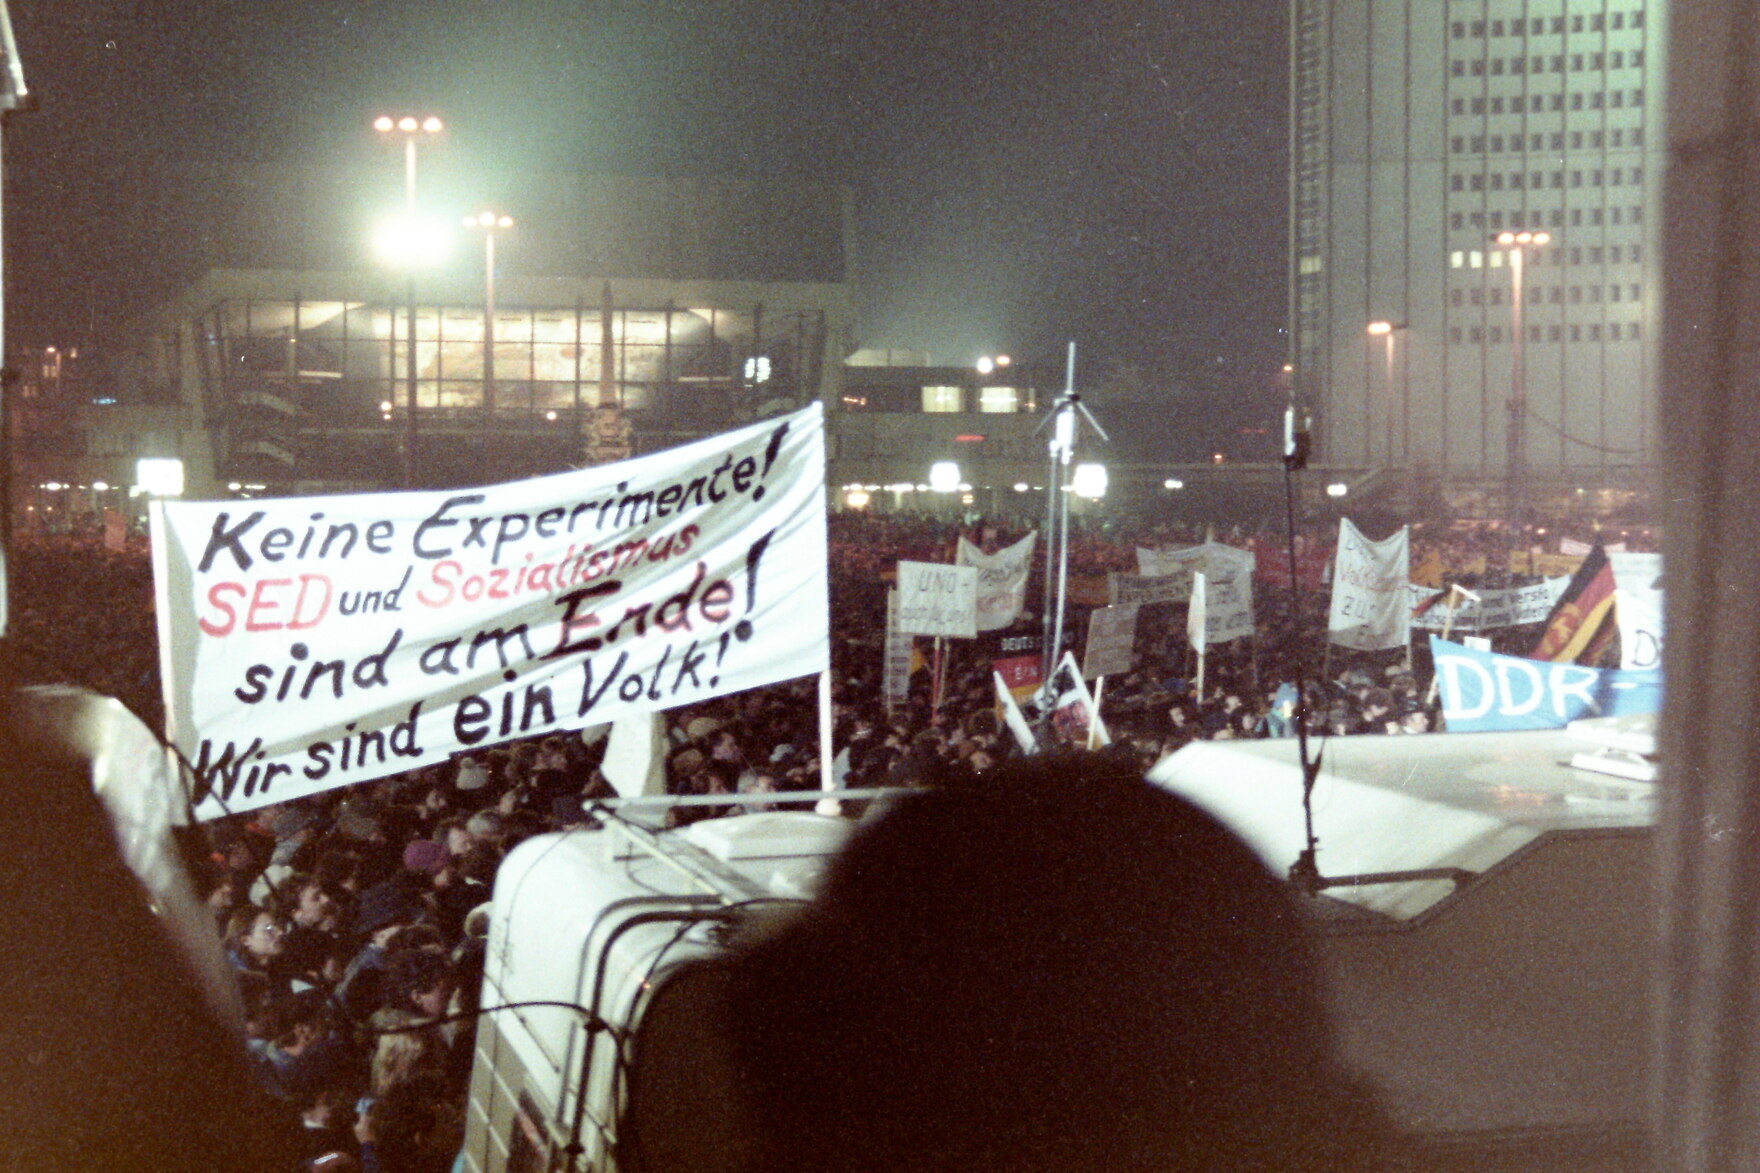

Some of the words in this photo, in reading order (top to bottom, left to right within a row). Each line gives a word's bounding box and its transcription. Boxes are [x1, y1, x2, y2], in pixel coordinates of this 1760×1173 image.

[198, 510, 394, 573] Keine
[413, 421, 789, 565] Experimente!
[199, 573, 333, 636] SED
[338, 565, 413, 616] und
[416, 523, 700, 609] Sozialismus
[234, 628, 403, 703] sind
[419, 623, 535, 676] am
[537, 527, 777, 662] Ende!
[193, 737, 292, 805] Wir
[303, 700, 424, 780] sind
[453, 669, 556, 746] ein
[578, 631, 730, 718] Volk!
[1436, 654, 1637, 721] DDR-
